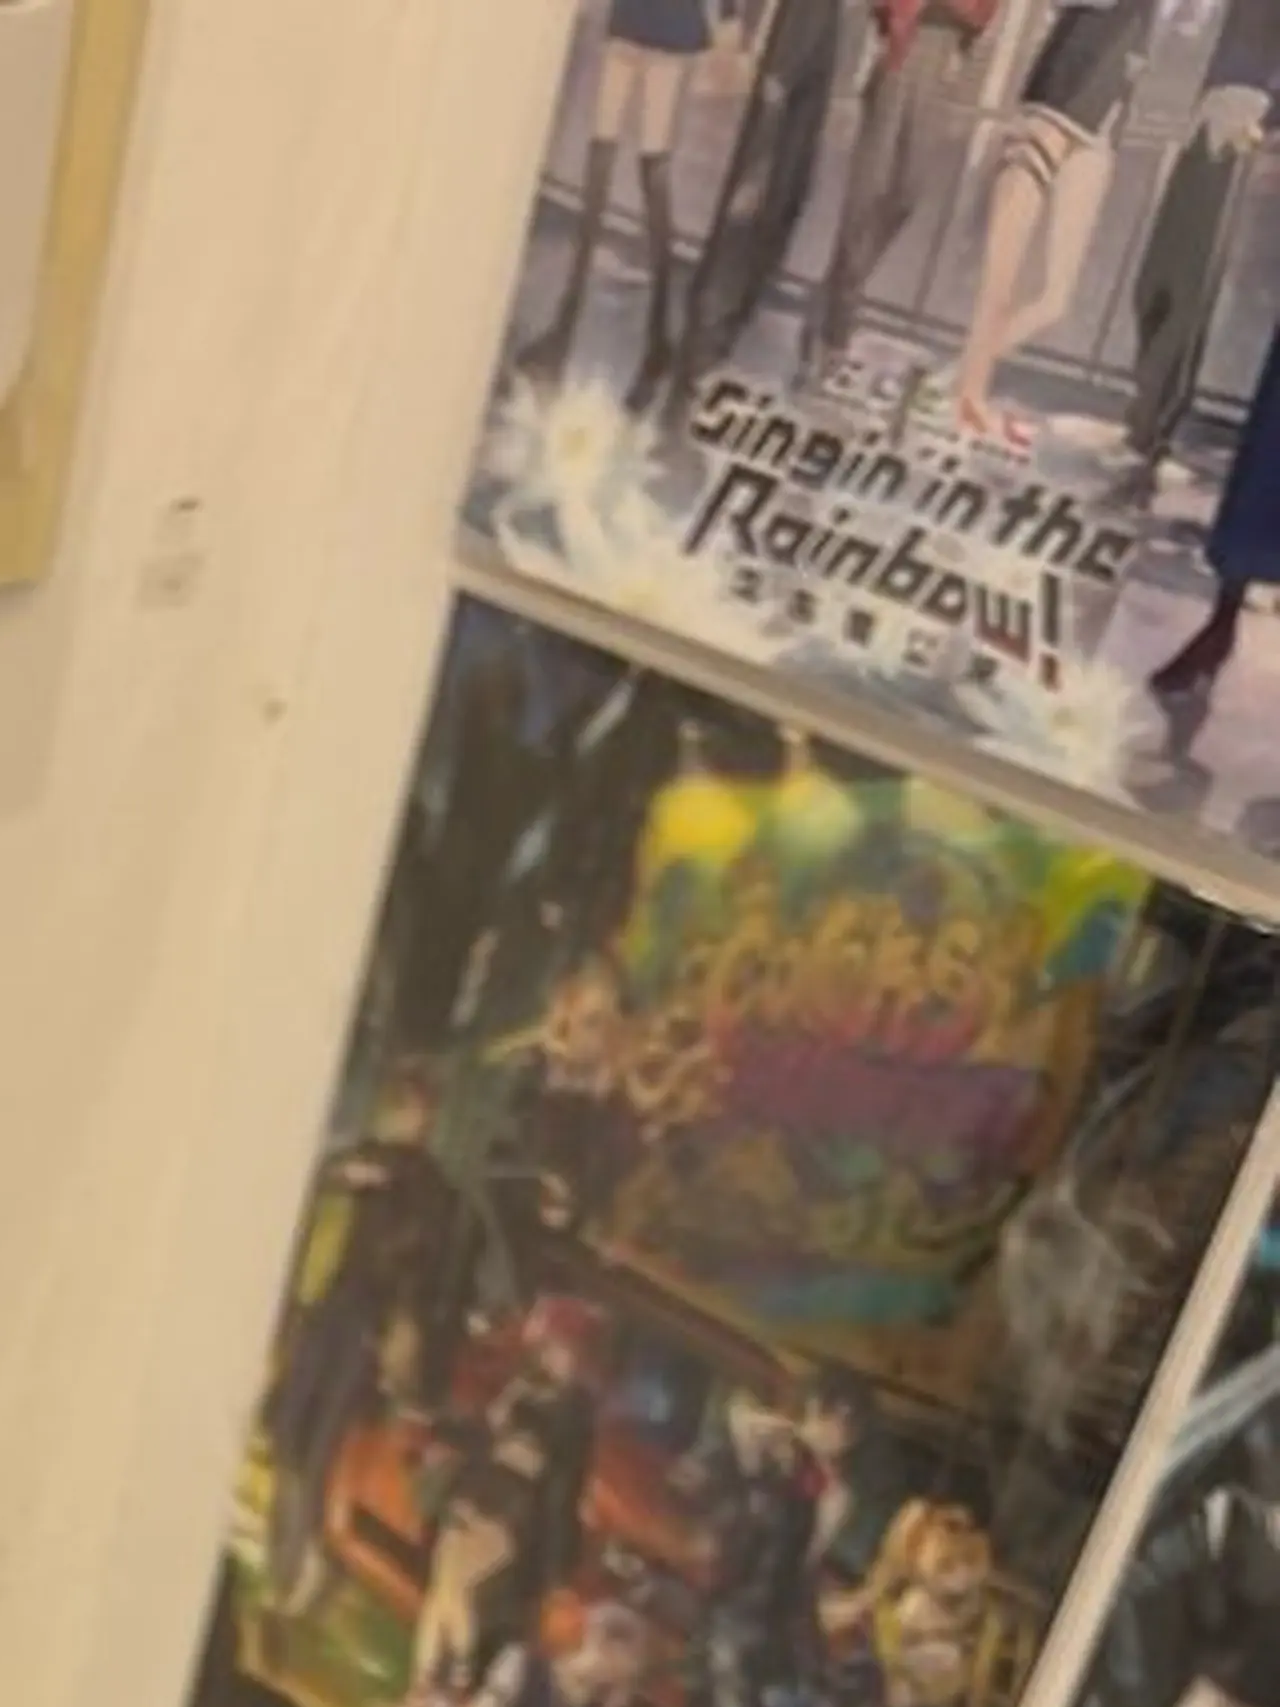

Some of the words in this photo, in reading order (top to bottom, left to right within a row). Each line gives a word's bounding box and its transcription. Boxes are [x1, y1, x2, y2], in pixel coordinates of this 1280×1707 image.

[681, 462, 1062, 693] Rainbow!
[912, 454, 987, 533] in
[992, 483, 1137, 584] the
